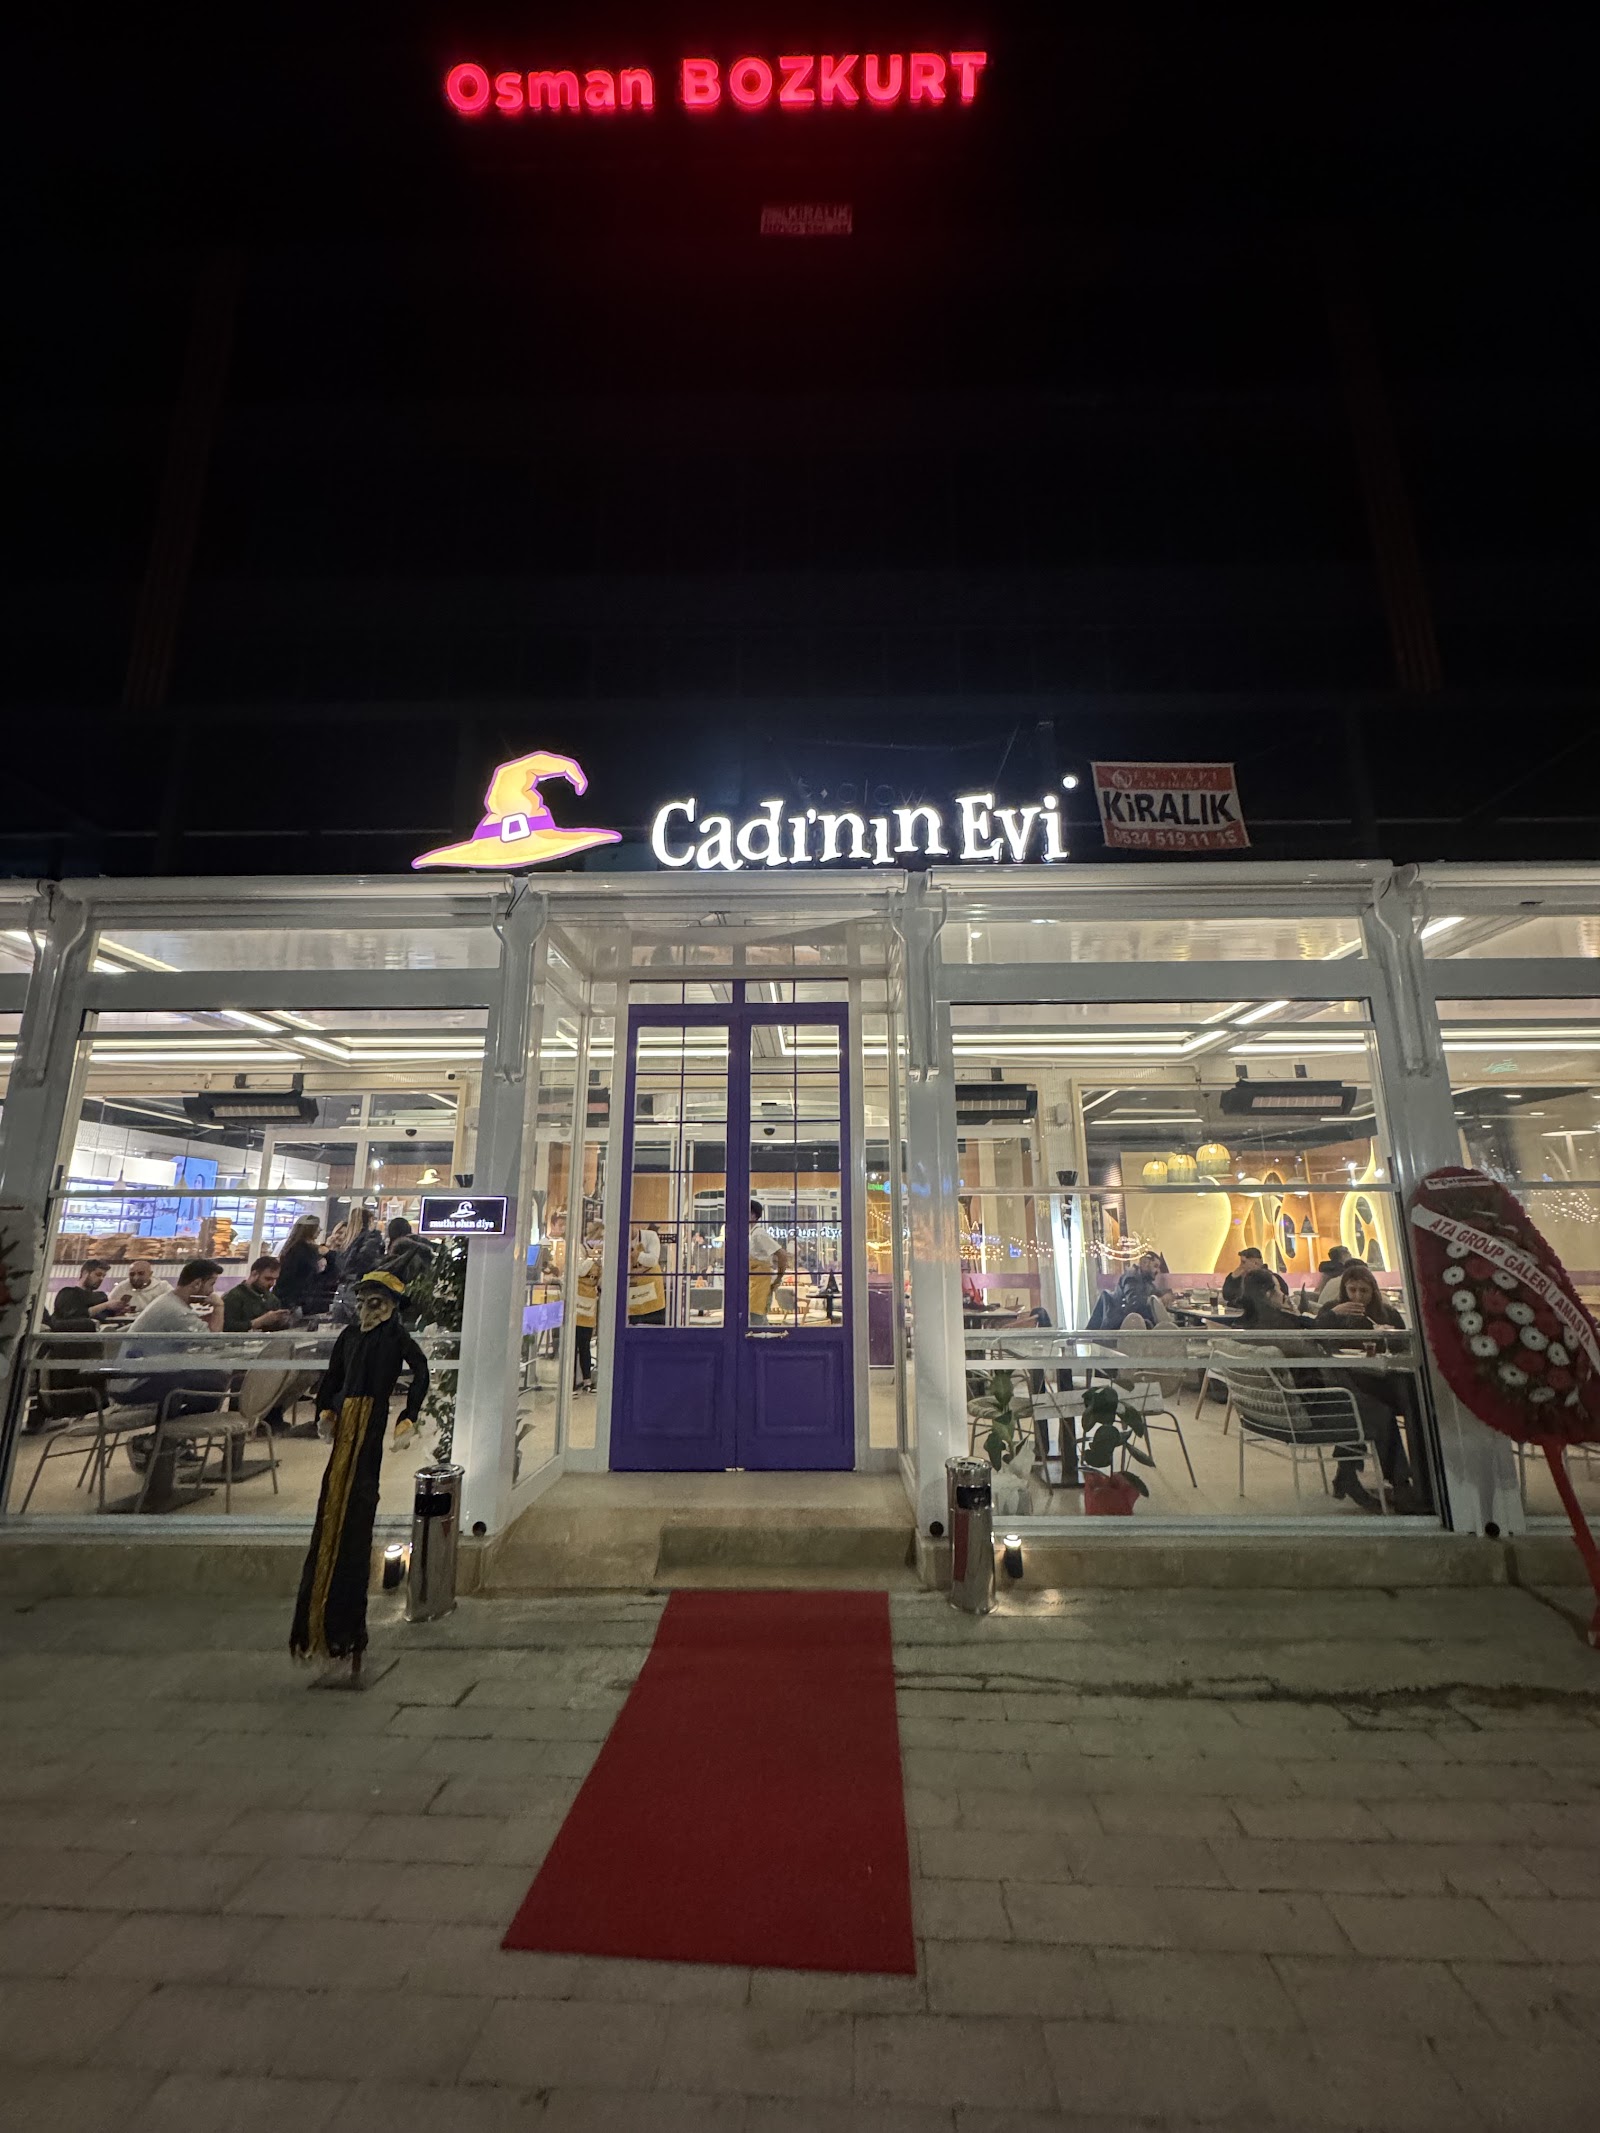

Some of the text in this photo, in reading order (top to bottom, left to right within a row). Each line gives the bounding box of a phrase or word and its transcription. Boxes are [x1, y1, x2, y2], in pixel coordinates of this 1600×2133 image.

[446, 51, 988, 111] Osman BOZKURT
[652, 793, 1068, 871] Cadı'nın Evi
[1113, 829, 1151, 845] 0534
[1154, 831, 1186, 846] 519
[1190, 832, 1210, 847] 11
[1429, 1219, 1455, 1237] ATA
[1457, 1229, 1505, 1259] GROUP
[1554, 1297, 1592, 1345] AMASYA
